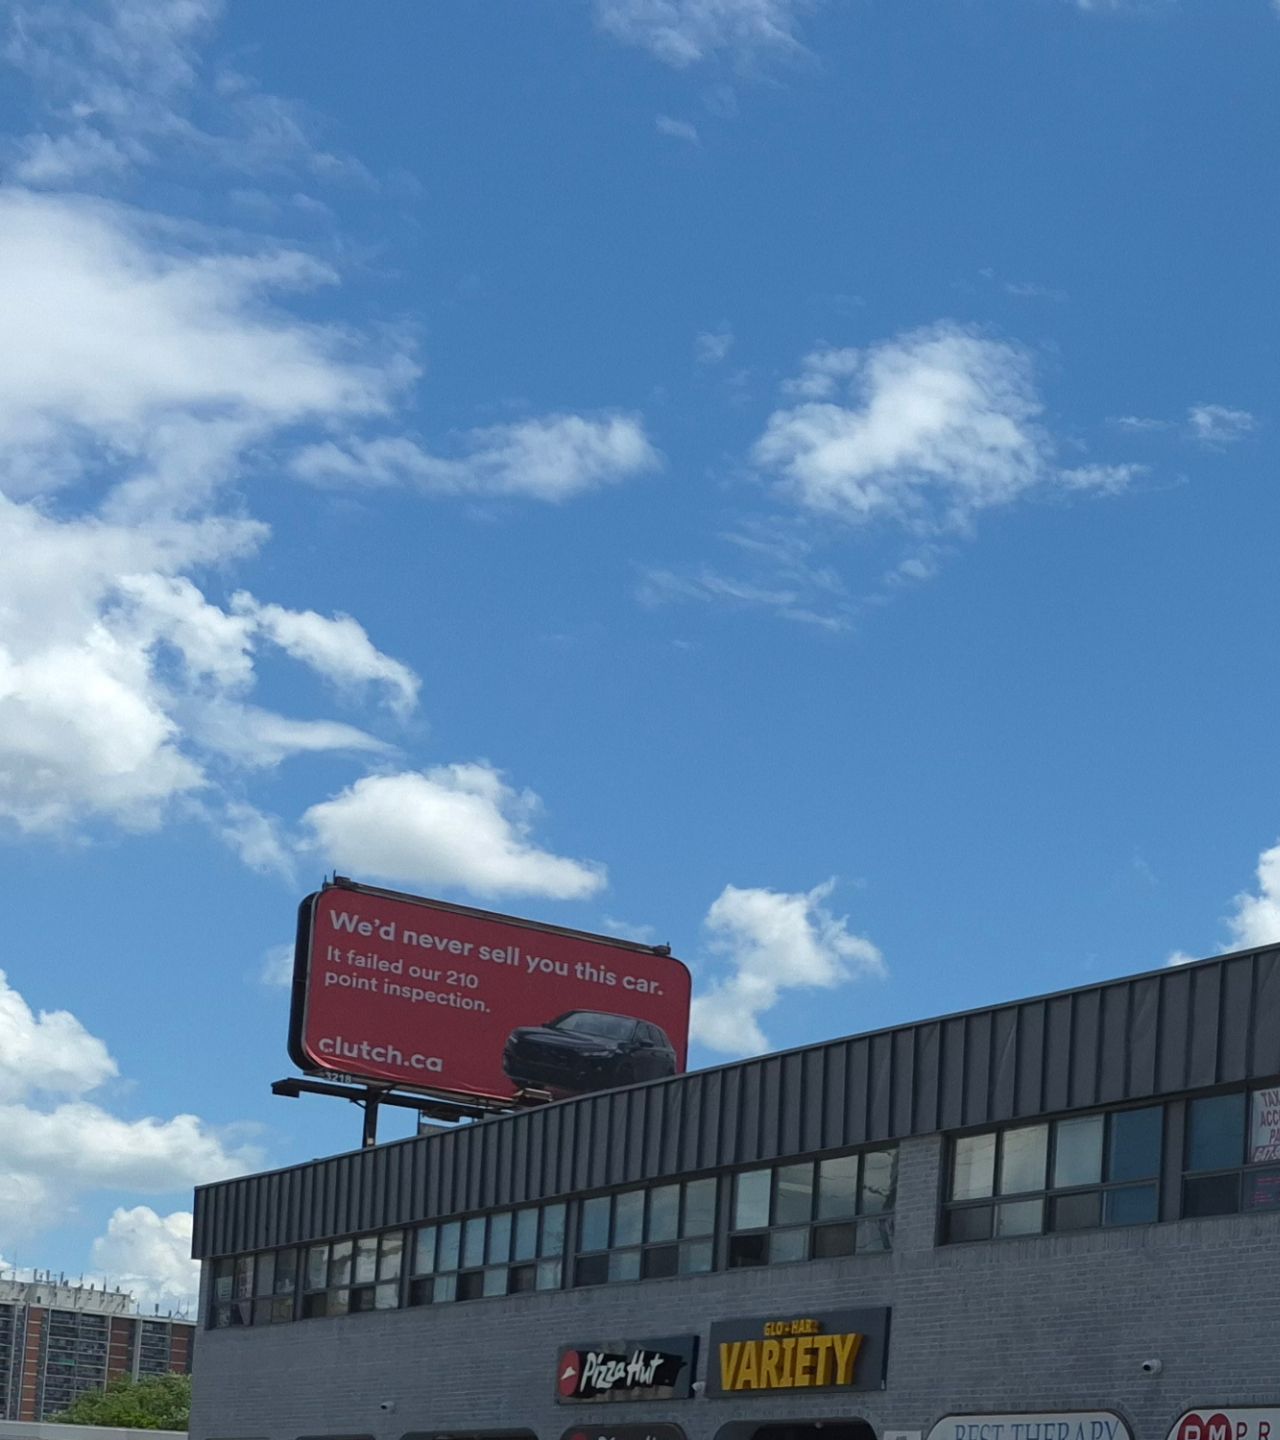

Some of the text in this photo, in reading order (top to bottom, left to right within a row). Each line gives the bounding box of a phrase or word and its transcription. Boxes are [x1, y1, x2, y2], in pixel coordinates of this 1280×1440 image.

[326, 945, 479, 989] It failed our 210
[402, 929, 474, 956] never
[478, 945, 520, 966] sell
[525, 954, 569, 976] you
[574, 961, 618, 986] this
[621, 974, 664, 996] car.
[324, 971, 491, 1013] point inspection.
[318, 1036, 443, 1072] clutch.ca
[580, 1350, 665, 1392] Pizza Hut
[719, 1333, 859, 1391] VARIETY
